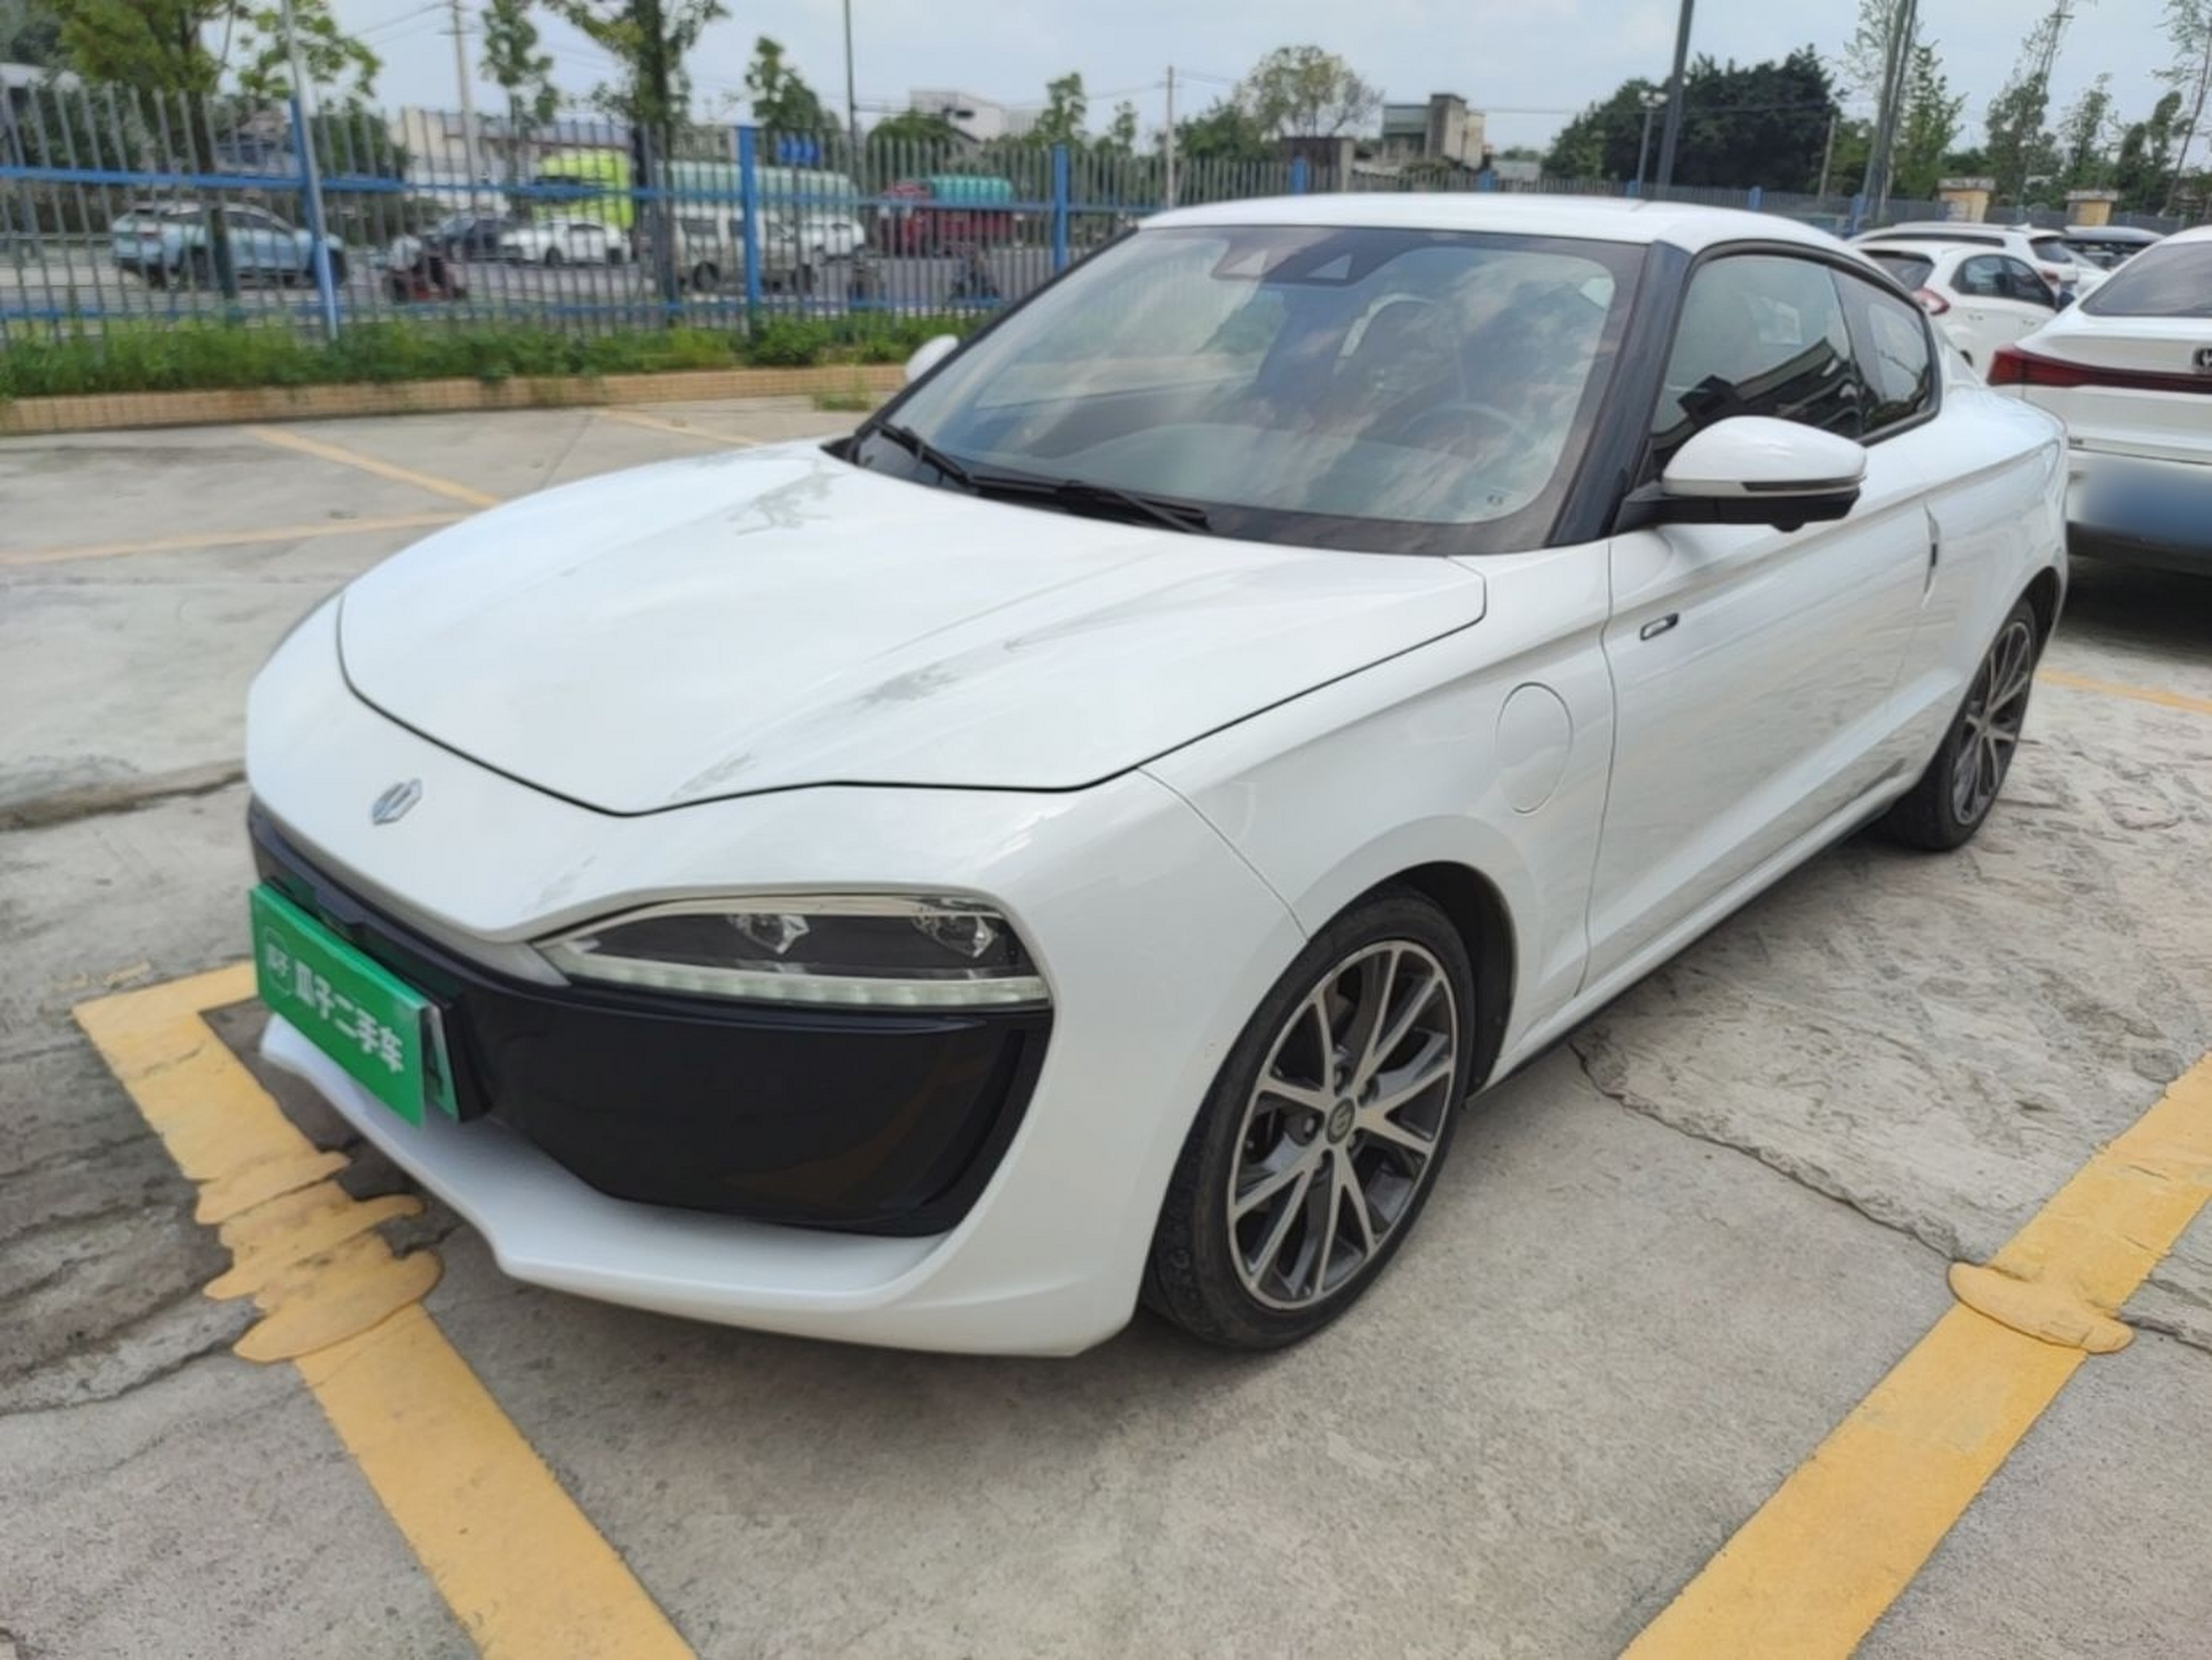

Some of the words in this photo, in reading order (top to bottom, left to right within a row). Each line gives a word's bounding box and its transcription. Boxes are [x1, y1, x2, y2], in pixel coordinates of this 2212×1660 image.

[295, 959, 404, 1073] 瓜子二手车
